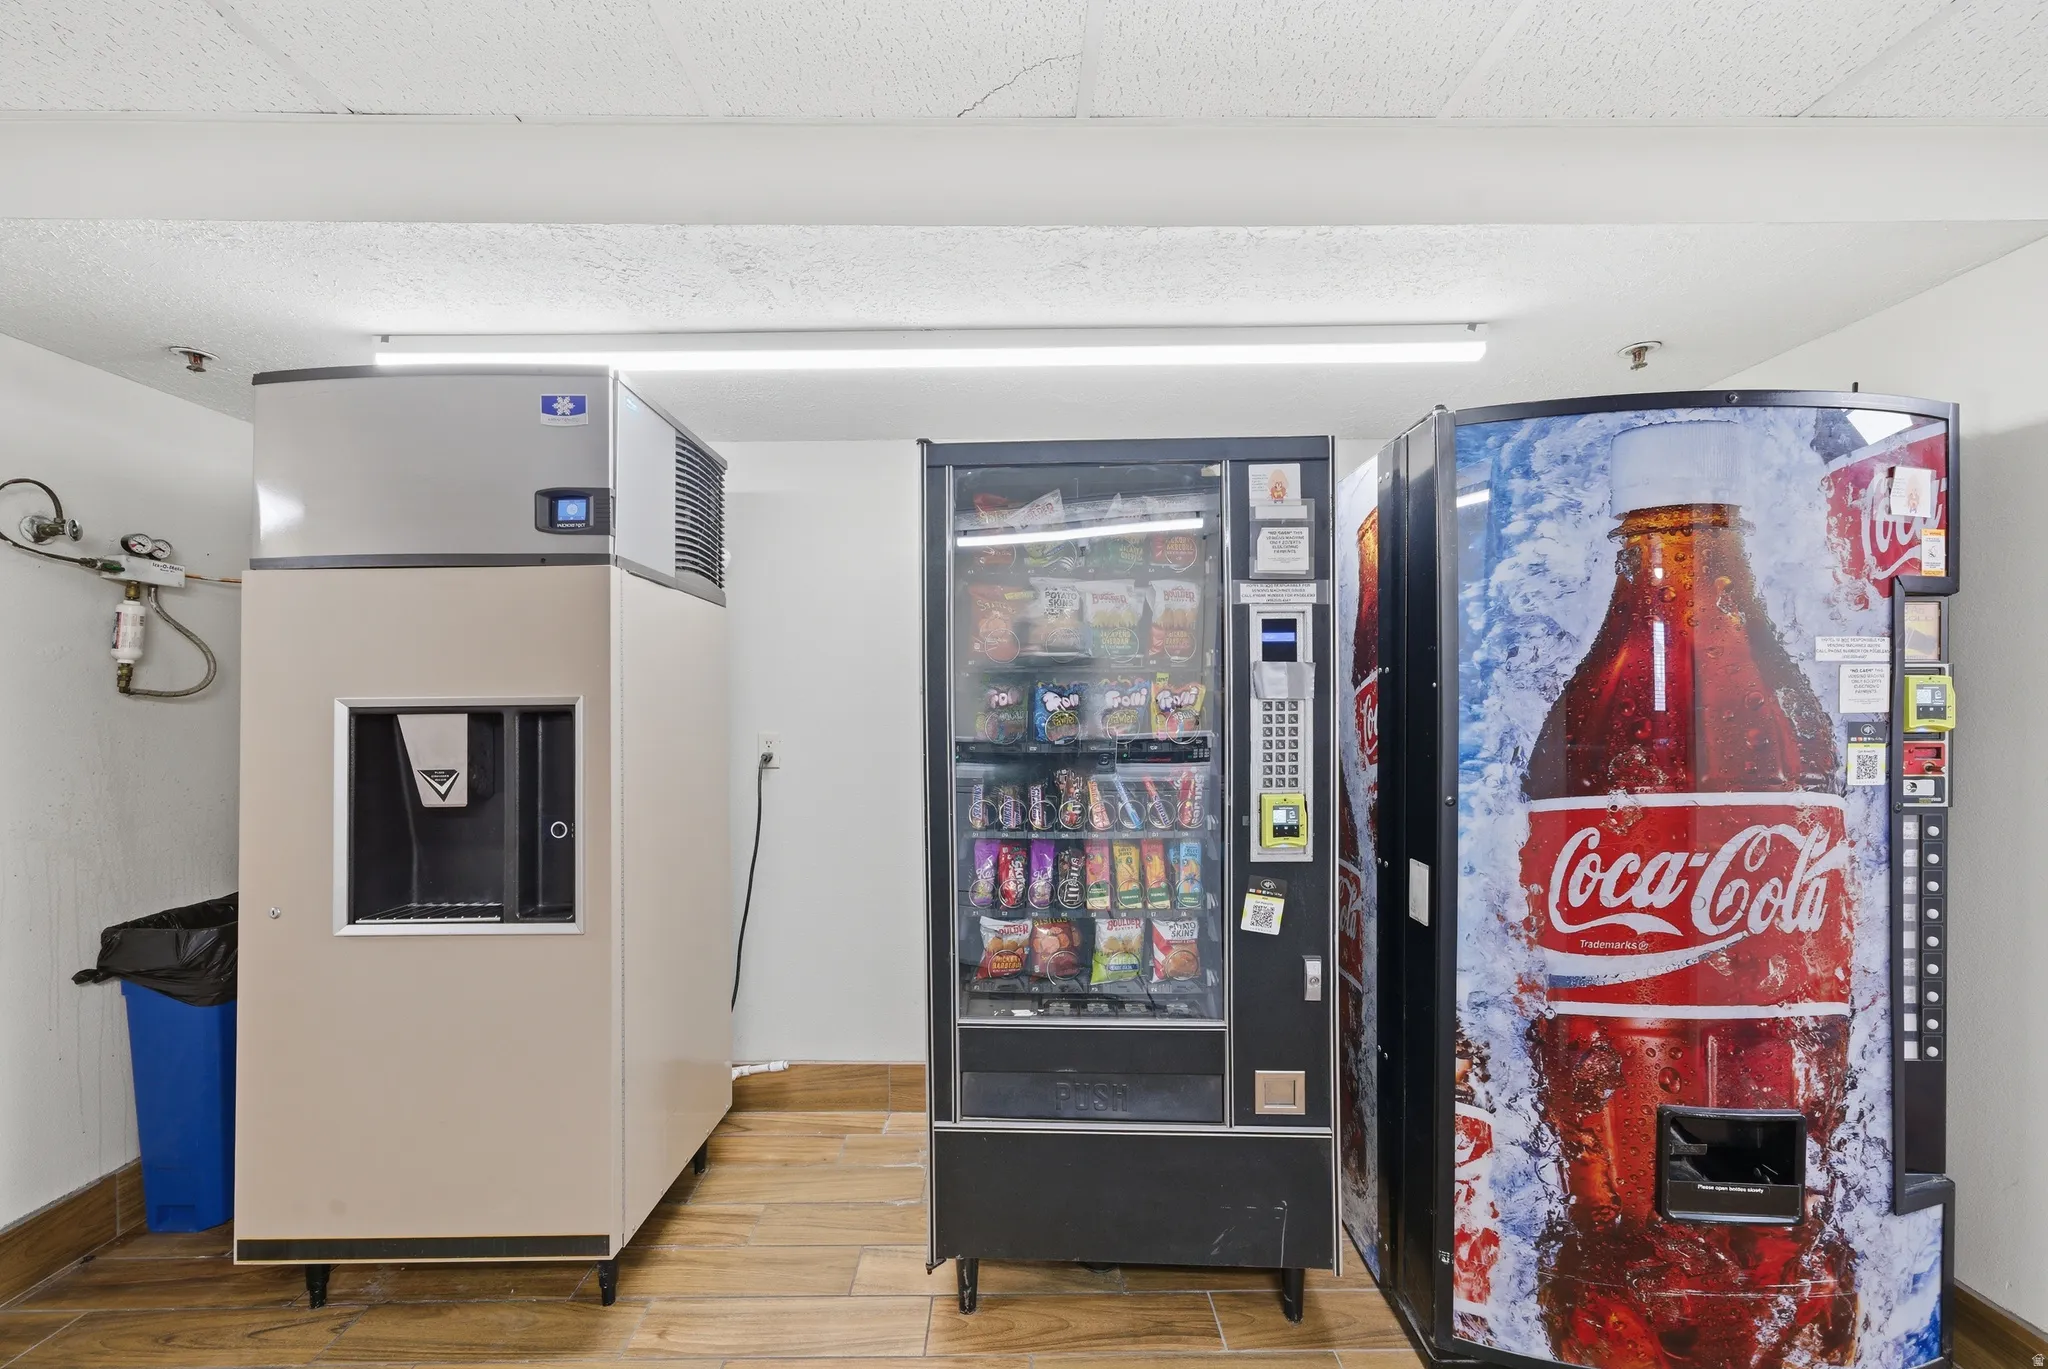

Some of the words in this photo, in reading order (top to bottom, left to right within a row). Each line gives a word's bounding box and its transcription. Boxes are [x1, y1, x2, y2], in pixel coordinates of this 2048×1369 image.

[1105, 687, 1148, 708] Trolli
[1549, 823, 1853, 938] Coca-Cola
[1170, 929, 1195, 938] SKINS
[1055, 1082, 1128, 1112] PUSH
